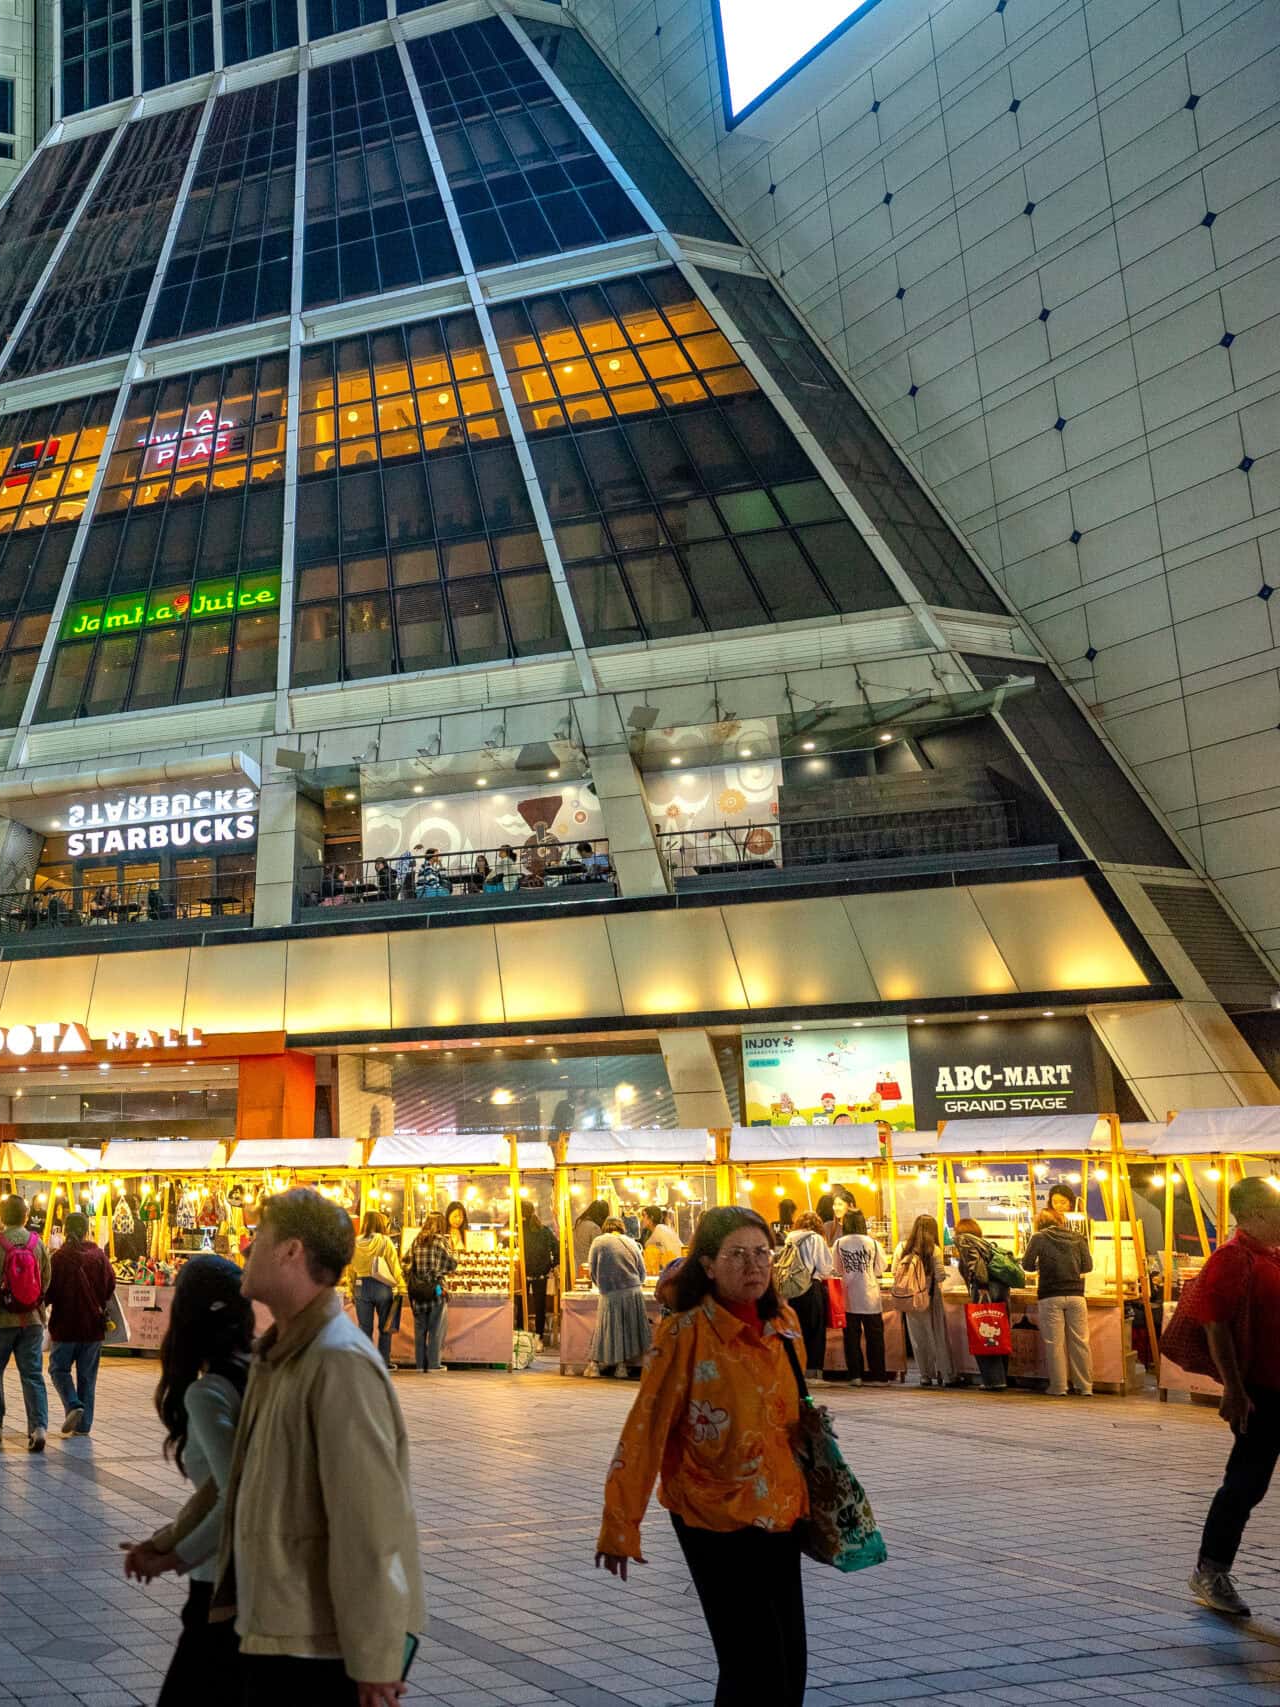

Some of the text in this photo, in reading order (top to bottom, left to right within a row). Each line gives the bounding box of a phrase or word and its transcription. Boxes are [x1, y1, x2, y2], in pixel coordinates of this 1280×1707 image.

[196, 409, 213, 424] A
[193, 590, 275, 614] Juice
[67, 814, 256, 857] STARBUCKS
[107, 1027, 203, 1050] MALL
[745, 1038, 781, 1049] INJOY
[935, 1065, 1072, 1092] ABC-MART
[944, 1098, 1067, 1113] GRAND STAGE
